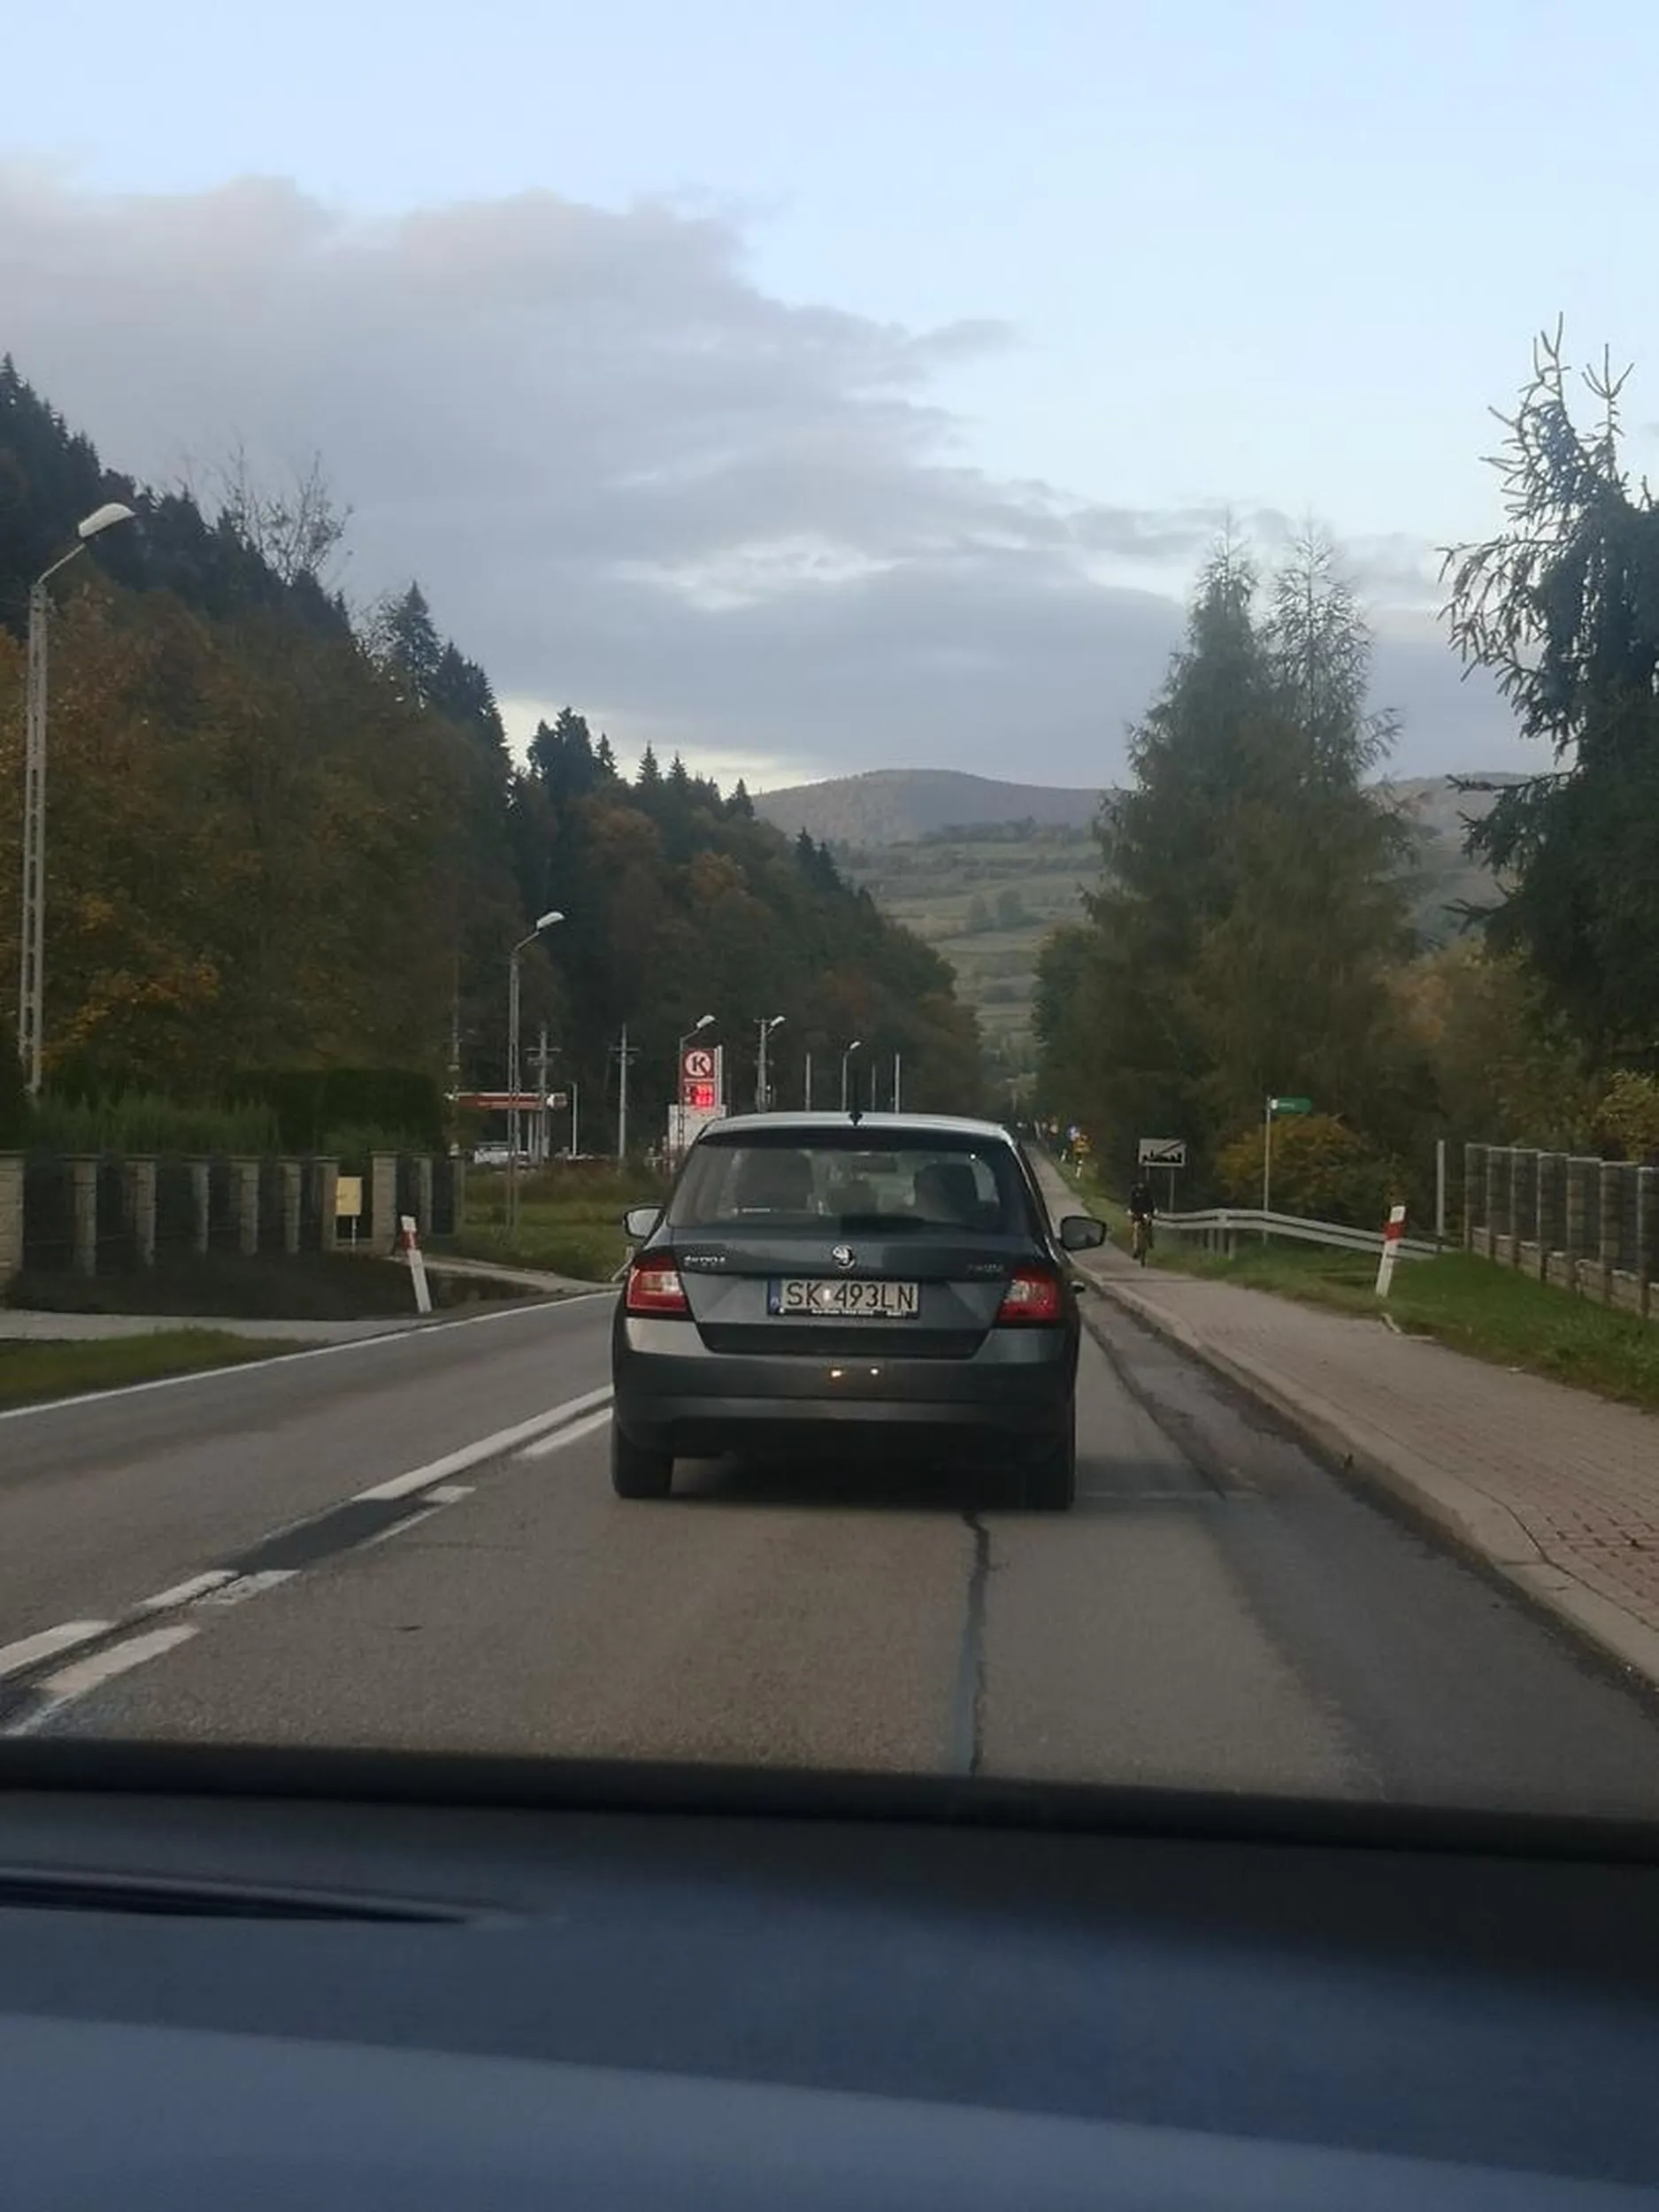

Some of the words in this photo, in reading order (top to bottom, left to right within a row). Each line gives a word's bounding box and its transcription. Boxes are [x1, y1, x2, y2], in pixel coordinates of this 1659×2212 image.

[692, 1056, 708, 1075] K
[787, 1282, 822, 1307] SK
[833, 1283, 914, 1310] 493LN
